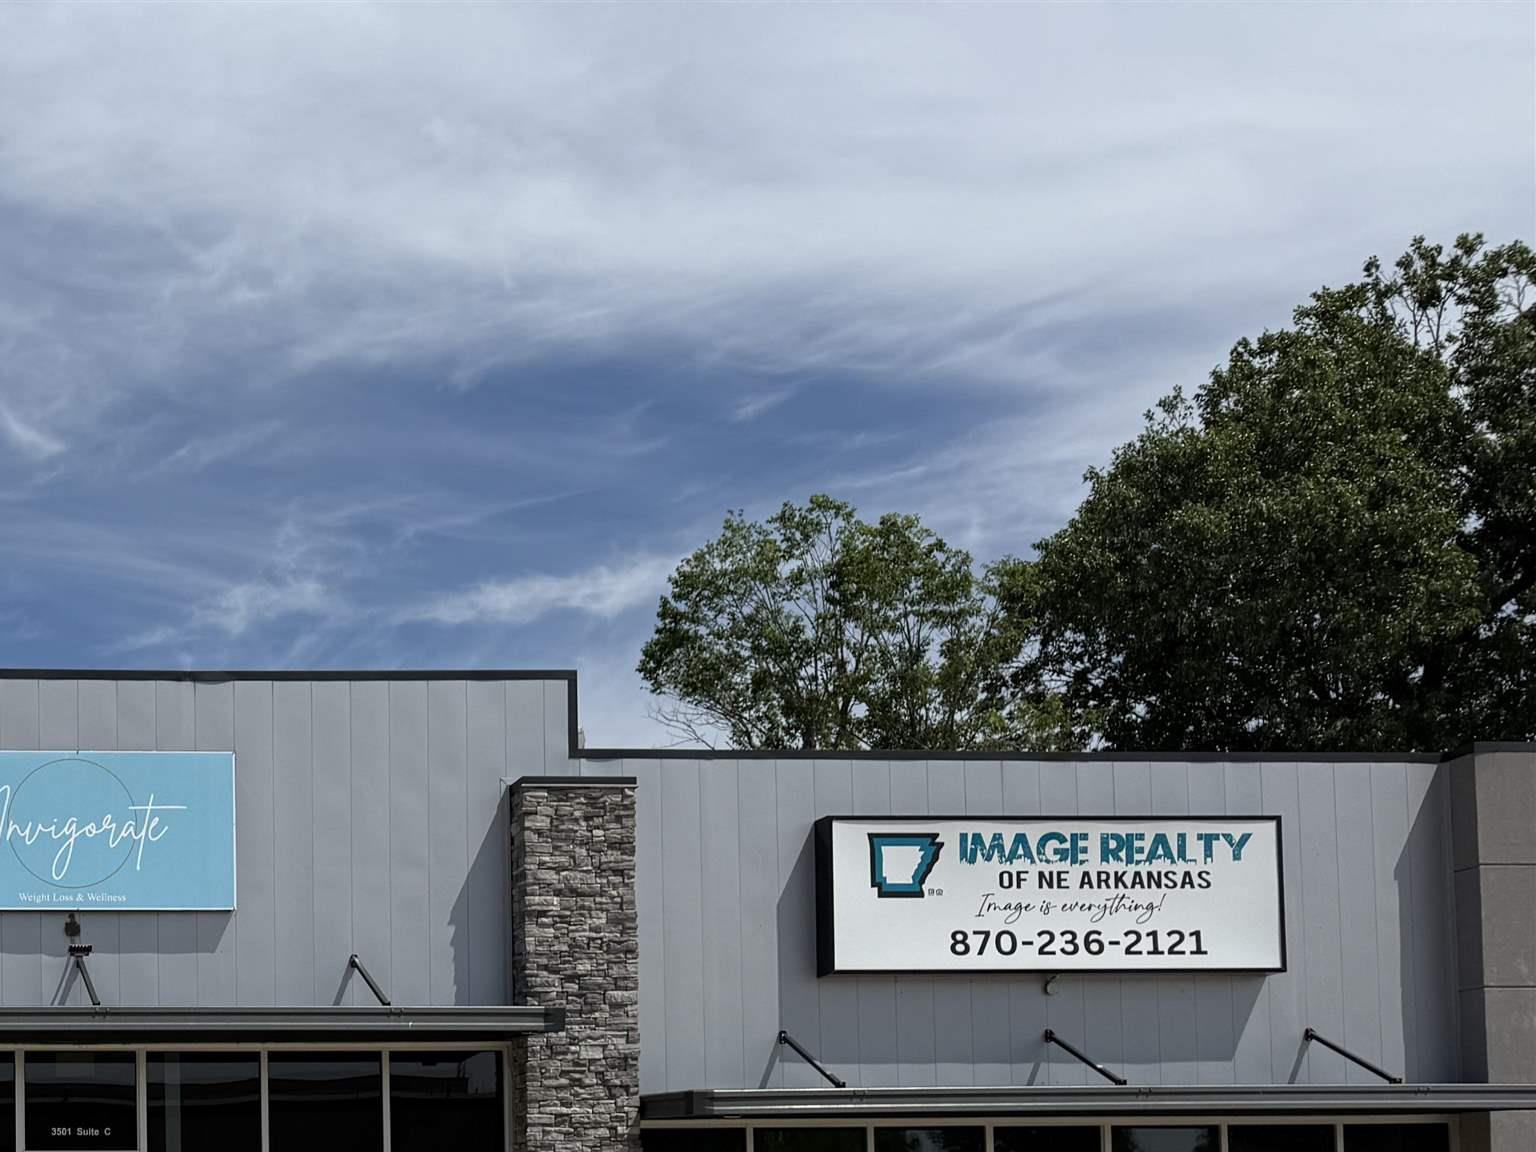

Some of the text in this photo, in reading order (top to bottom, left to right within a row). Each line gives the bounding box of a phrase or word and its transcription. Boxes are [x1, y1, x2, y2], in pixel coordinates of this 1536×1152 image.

[959, 832, 1253, 866] IMAGE REALTY
[999, 870, 1212, 889] OF NE ARKANSAS
[18, 892, 127, 903] Weight Loss & Wellness
[975, 893, 1167, 925] Image is everything!
[949, 929, 1208, 956] 870-236-2121
[51, 1127, 111, 1136] 3501 Suite C
